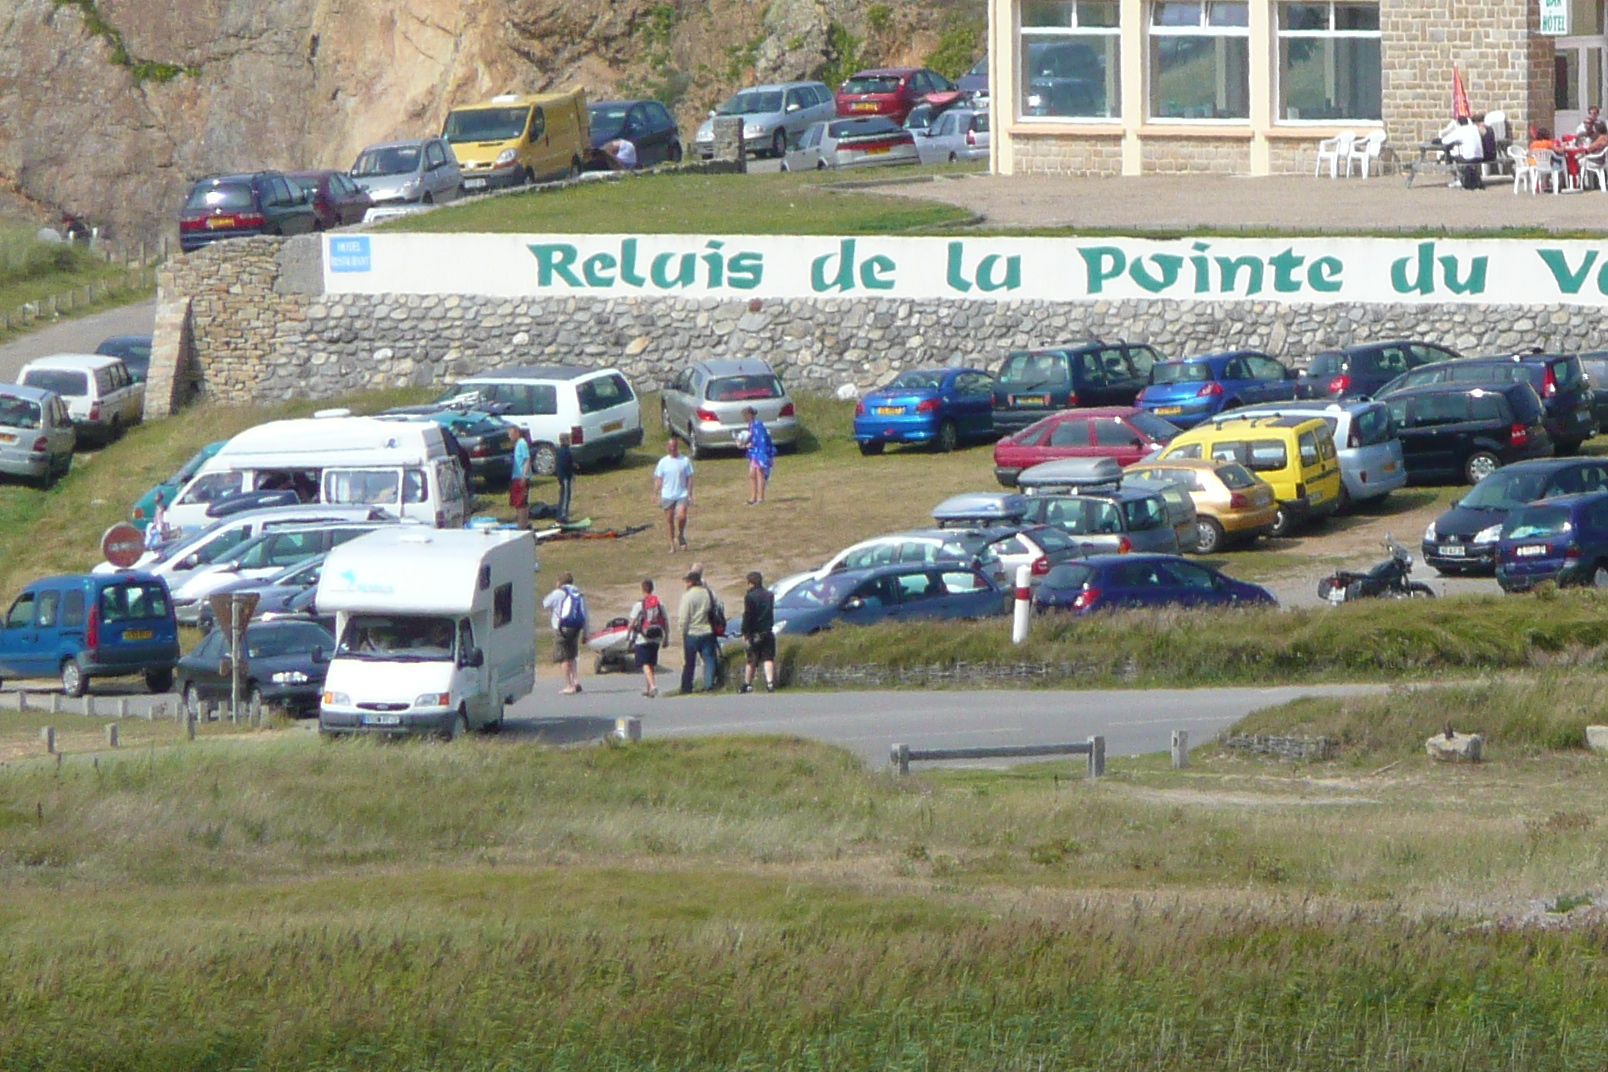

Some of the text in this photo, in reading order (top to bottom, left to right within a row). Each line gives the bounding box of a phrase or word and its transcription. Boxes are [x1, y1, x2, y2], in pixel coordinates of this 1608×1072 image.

[530, 237, 765, 290] Relais
[812, 237, 897, 293] de
[948, 240, 1022, 293] la
[1079, 241, 1343, 296] Pointe
[1391, 241, 1488, 295] du
